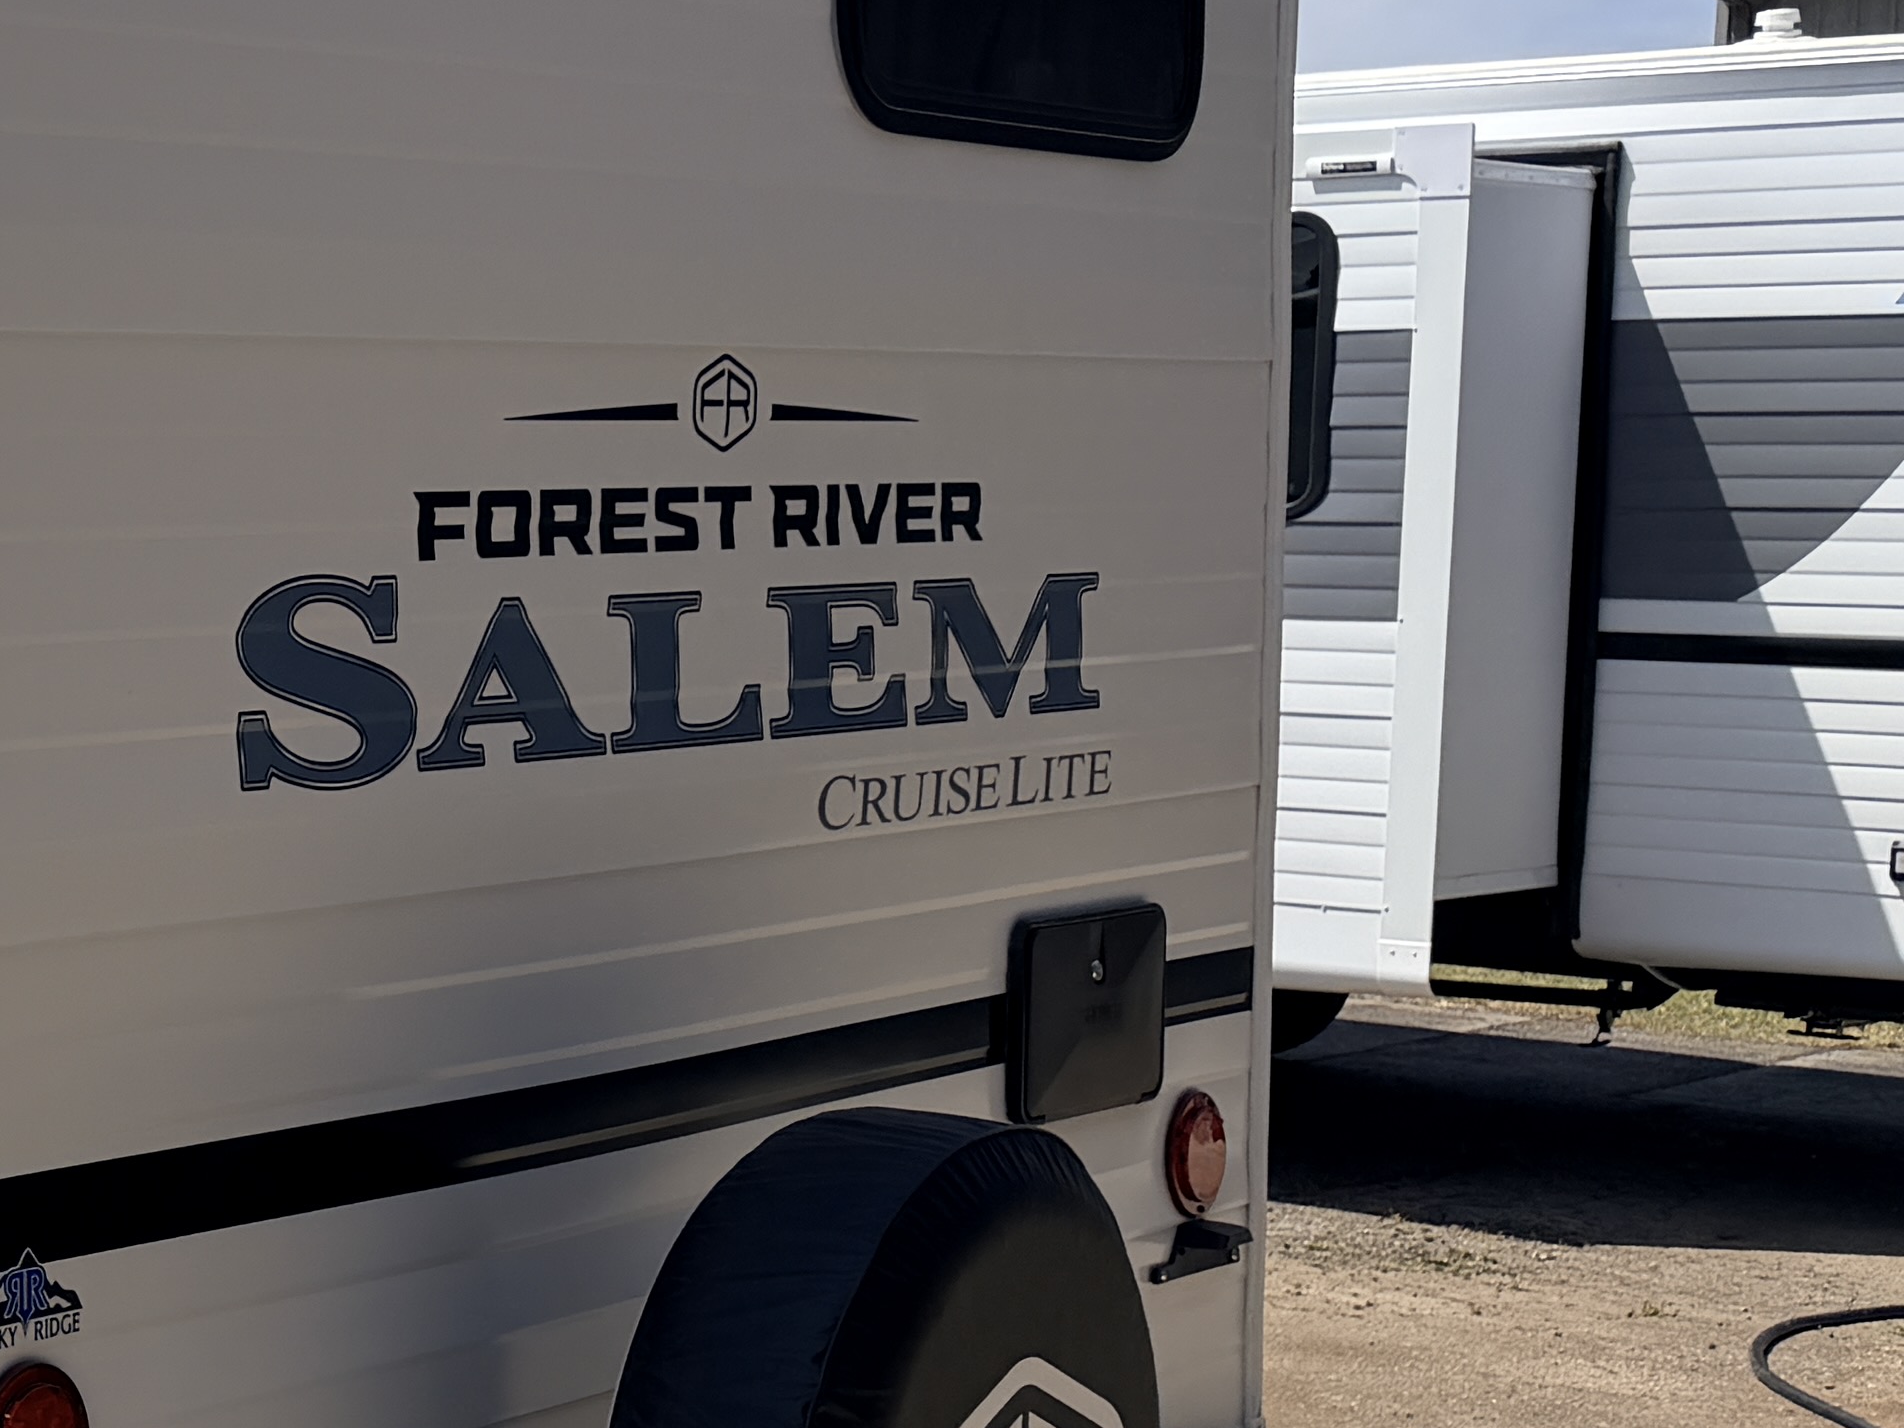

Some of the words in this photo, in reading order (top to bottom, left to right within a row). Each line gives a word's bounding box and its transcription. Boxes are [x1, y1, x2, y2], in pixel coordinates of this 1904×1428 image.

[412, 485, 753, 562] FOREST
[768, 481, 984, 548] RIVER
[234, 572, 1101, 792] SALEM
[33, 1311, 81, 1342] RIDGE
